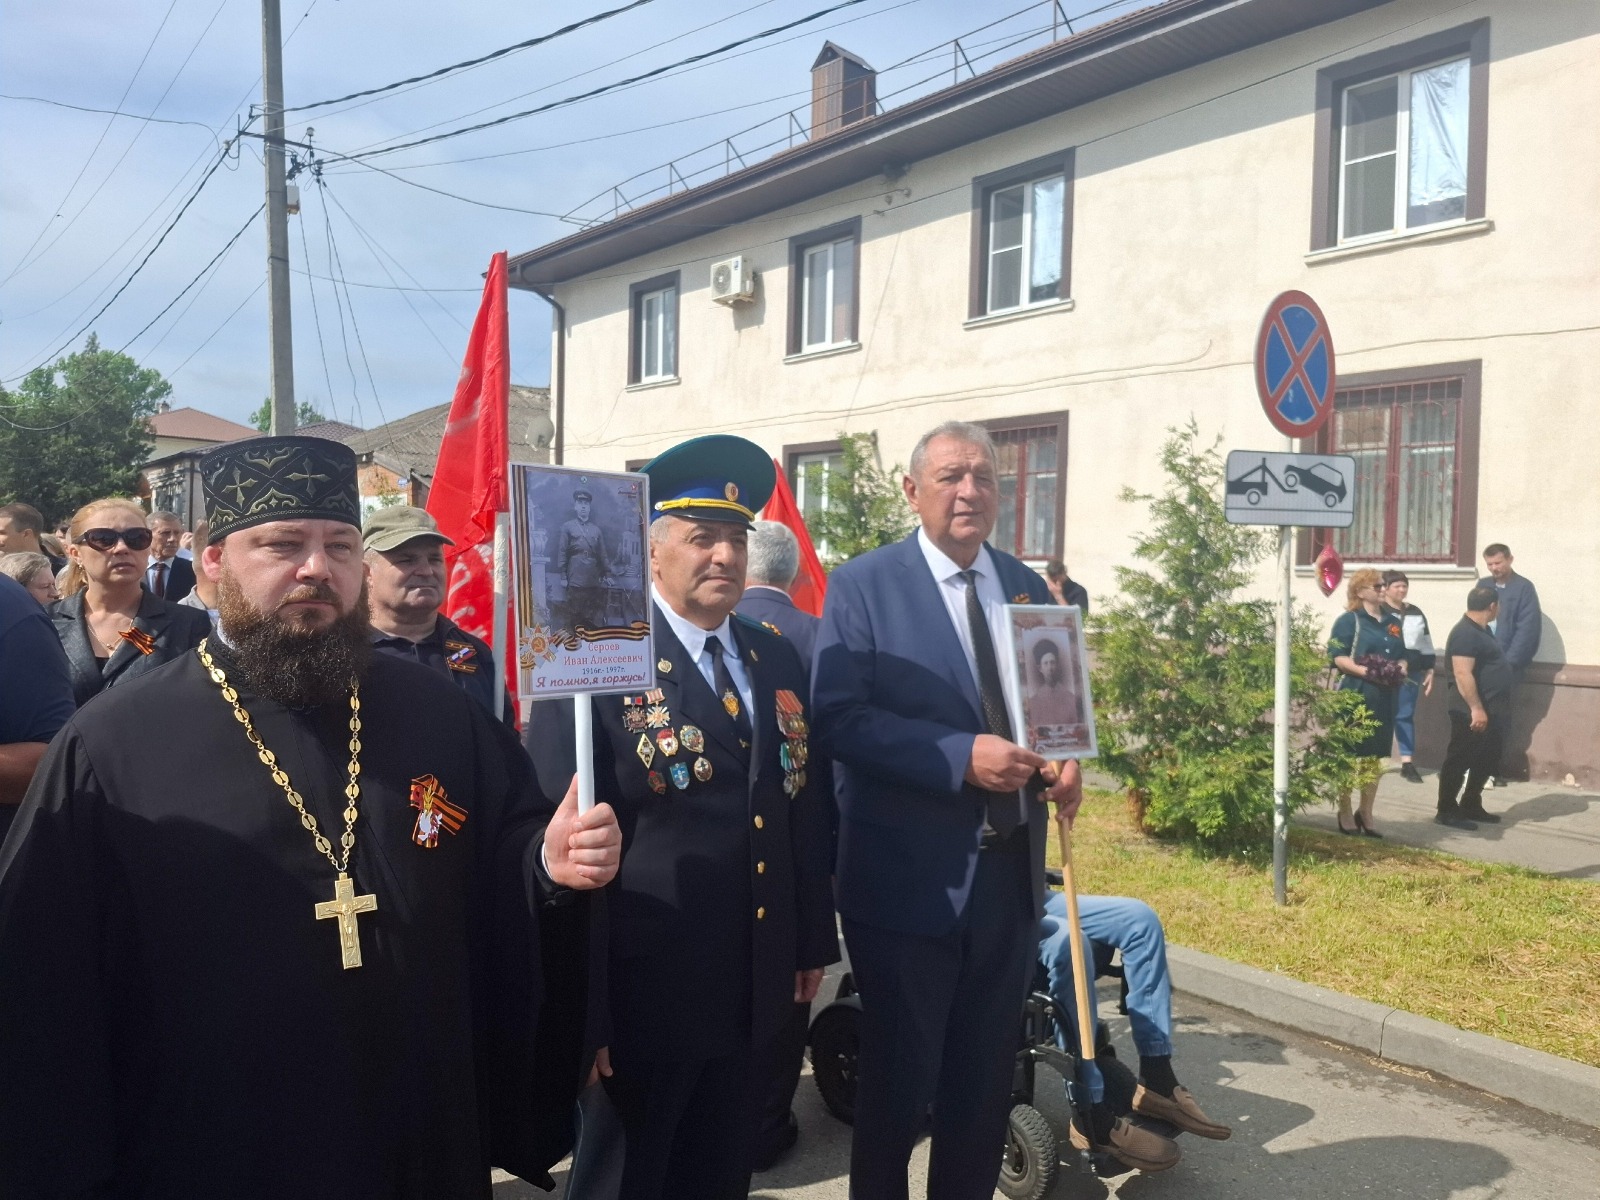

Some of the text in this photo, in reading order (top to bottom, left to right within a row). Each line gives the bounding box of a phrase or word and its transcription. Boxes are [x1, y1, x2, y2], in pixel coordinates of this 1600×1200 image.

[588, 643, 620, 653] Сероев
[564, 655, 643, 666] Иван Алексеевич
[536, 676, 547, 688] Я
[602, 672, 646, 685] горжусь!
